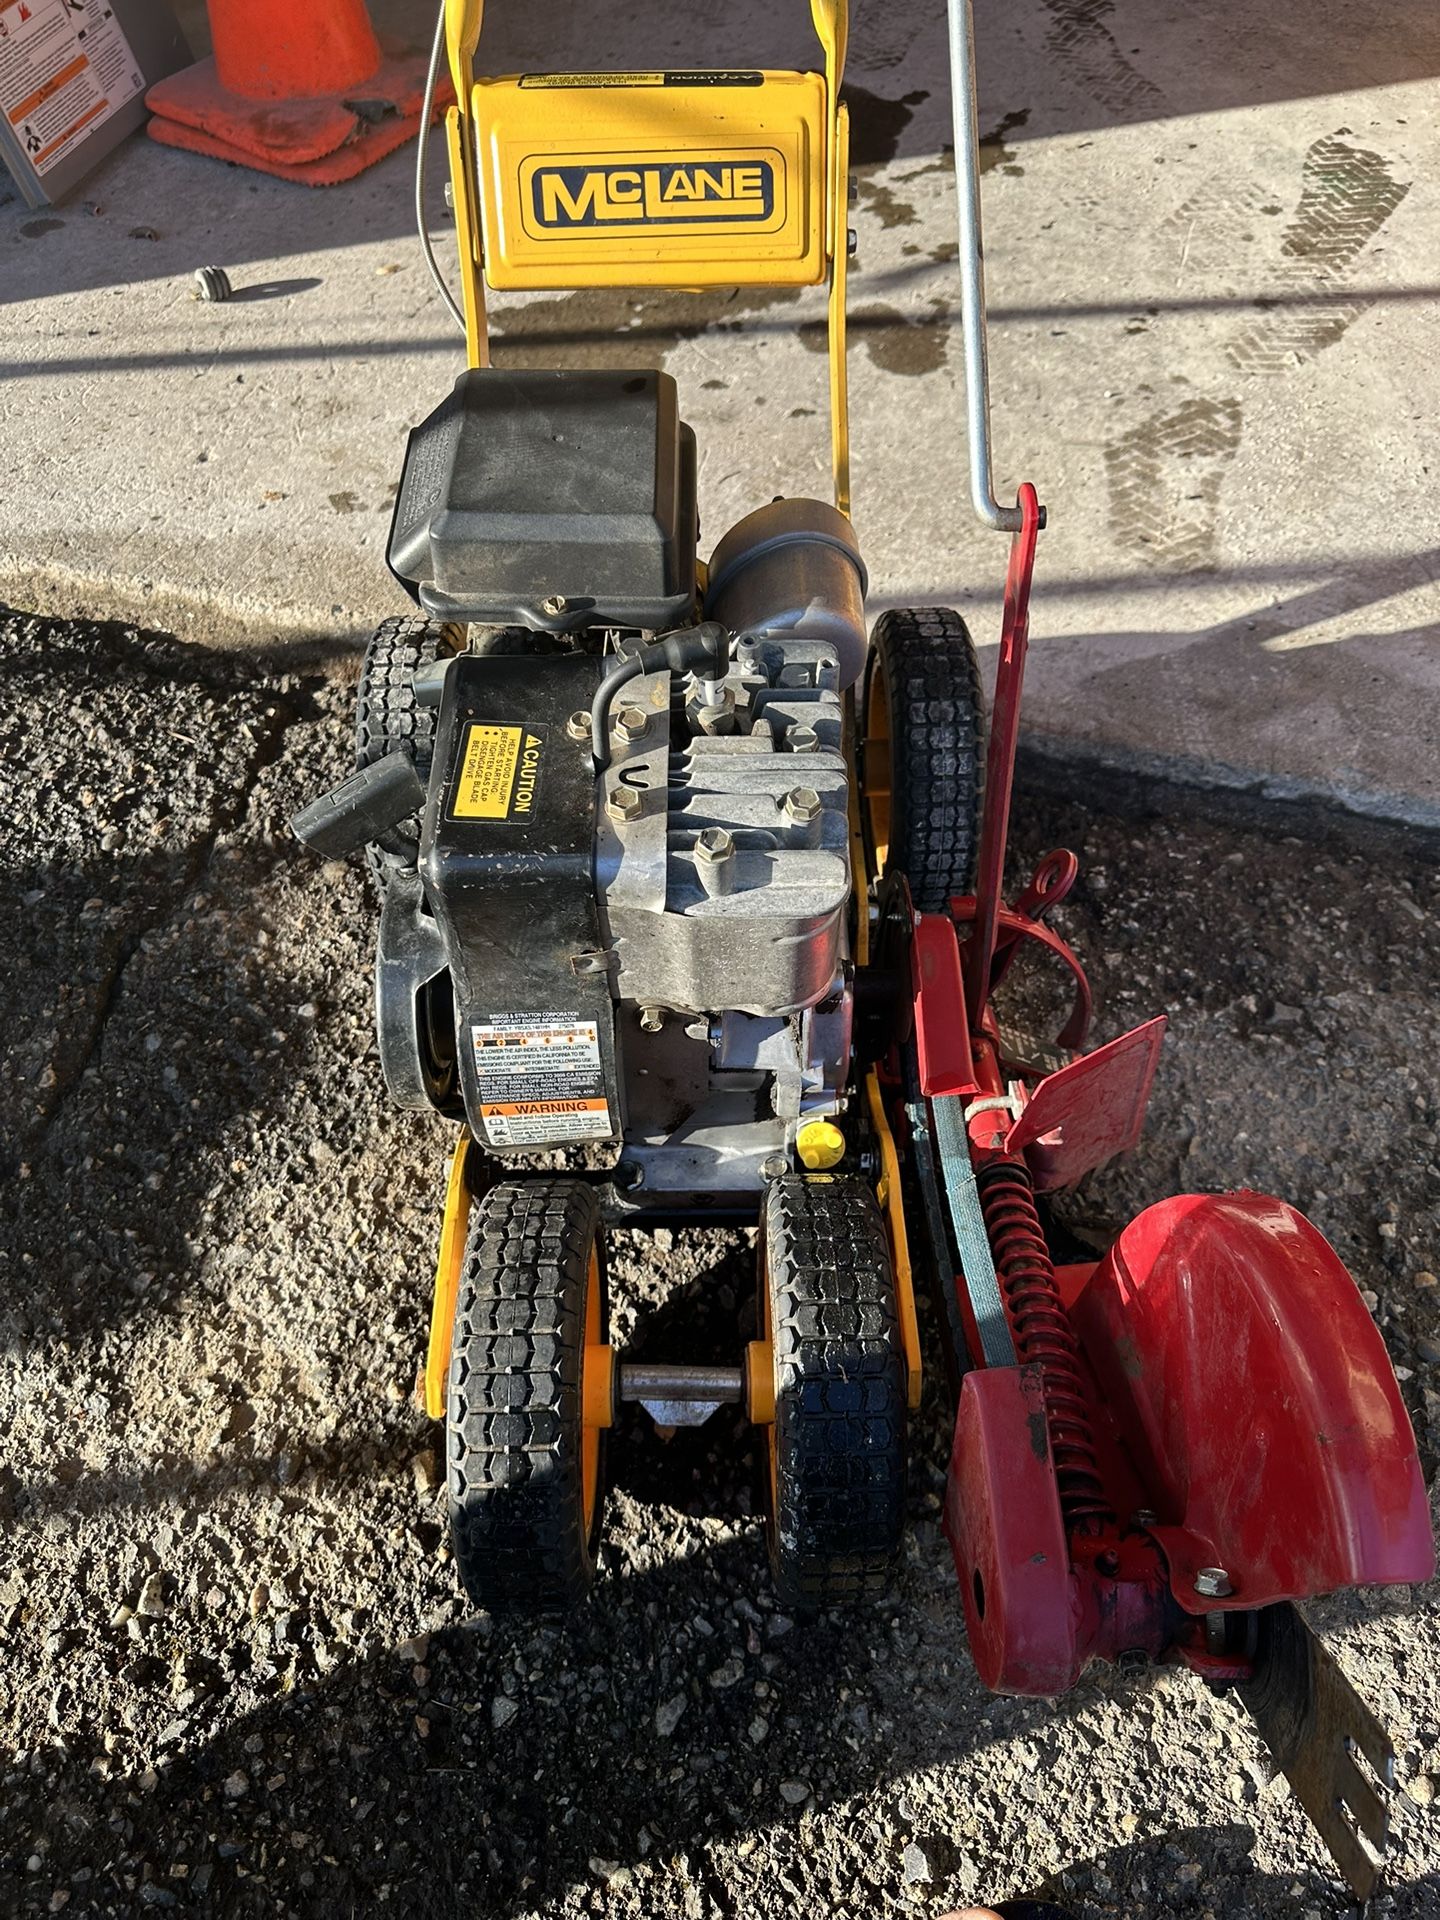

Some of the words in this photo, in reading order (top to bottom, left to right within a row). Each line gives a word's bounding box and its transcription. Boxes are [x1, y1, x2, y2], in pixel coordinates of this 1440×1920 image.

[470, 740, 480, 757] BELT
[498, 732, 508, 757] BEFORE
[507, 738, 516, 756] HELP
[474, 741, 489, 778] DISENGAGE
[486, 742, 498, 770] TIGHTEN
[466, 758, 476, 778] DRIVE
[502, 758, 512, 778] AVOID
[482, 772, 492, 786] GAS
[514, 750, 539, 812] CAUTION
[470, 781, 481, 804] BLADE
[481, 788, 489, 802] CAP
[498, 780, 509, 805] INJURY
[515, 1102, 588, 1114] WARNING
